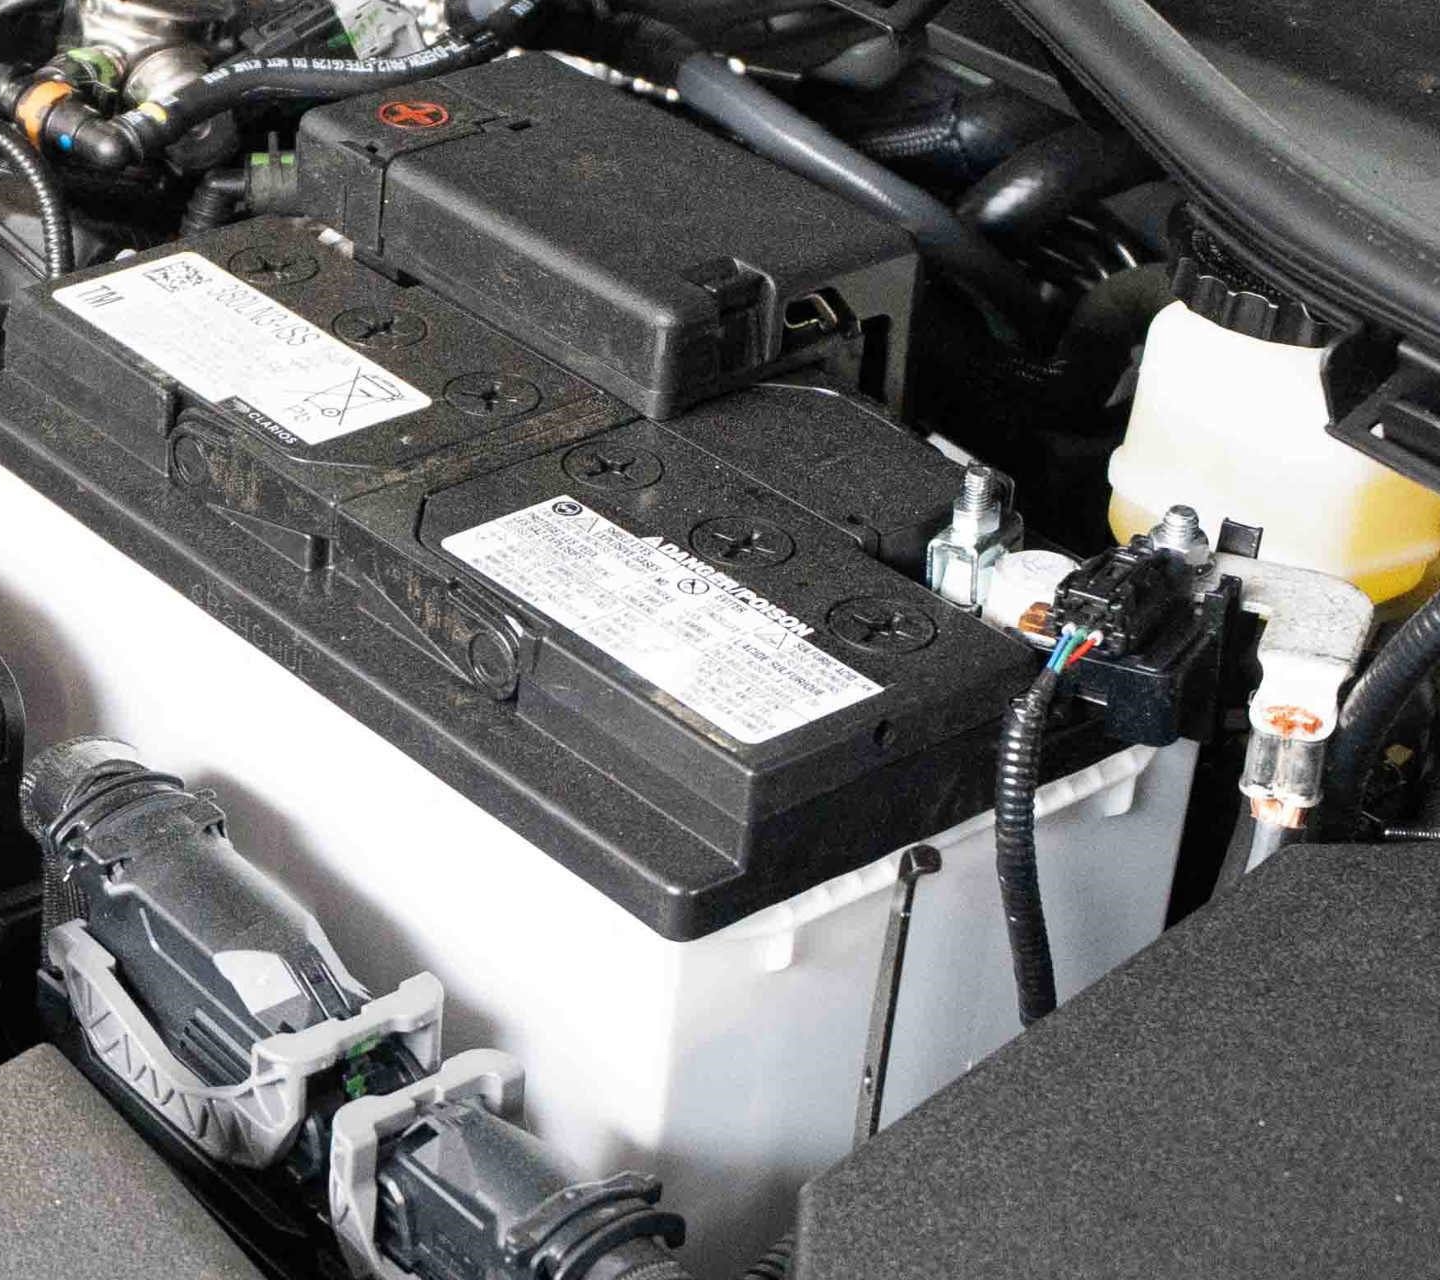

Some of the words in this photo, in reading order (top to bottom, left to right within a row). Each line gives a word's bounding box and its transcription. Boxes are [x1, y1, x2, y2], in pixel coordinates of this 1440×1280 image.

[77, 284, 126, 309] TM
[247, 411, 299, 446] CLARIOS
[659, 540, 815, 639] DANGER/POISON
